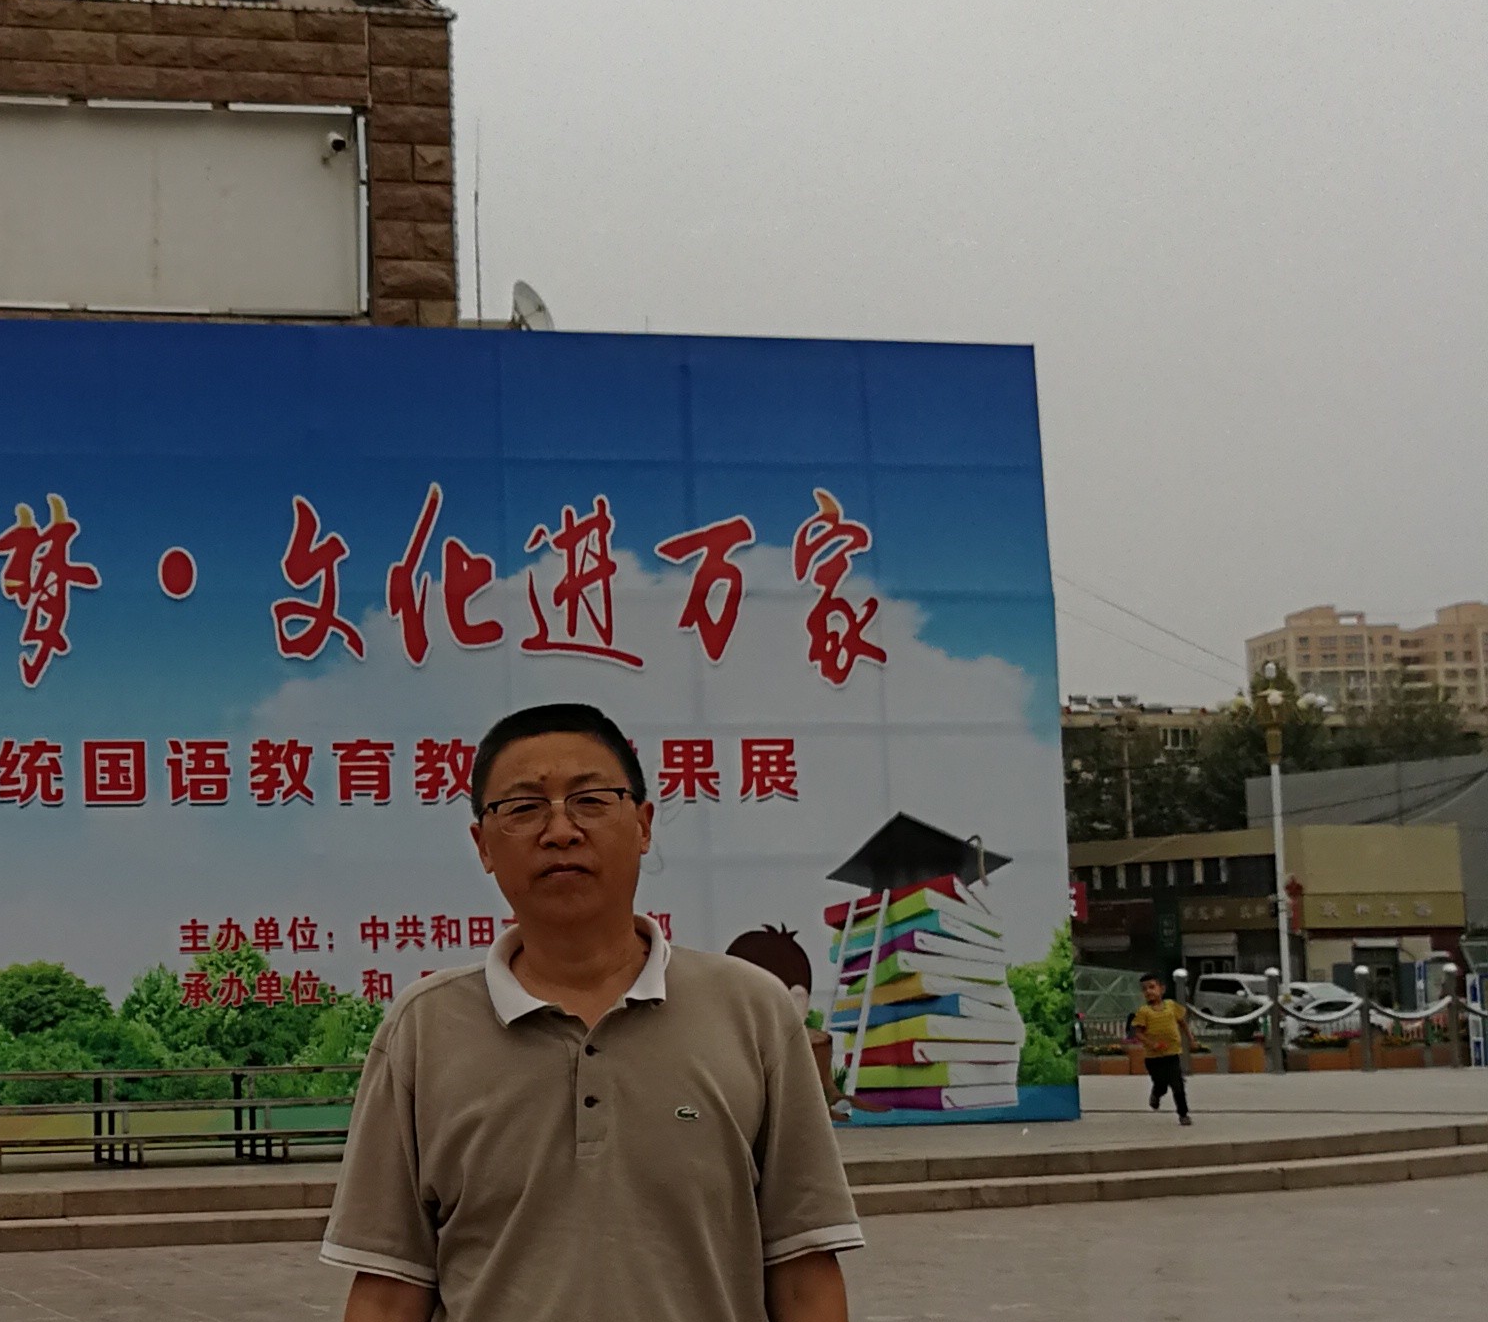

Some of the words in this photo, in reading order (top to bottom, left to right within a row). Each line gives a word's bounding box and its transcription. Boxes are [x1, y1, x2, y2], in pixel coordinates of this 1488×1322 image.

[181, 970, 437, 1008] 承办单位：和
